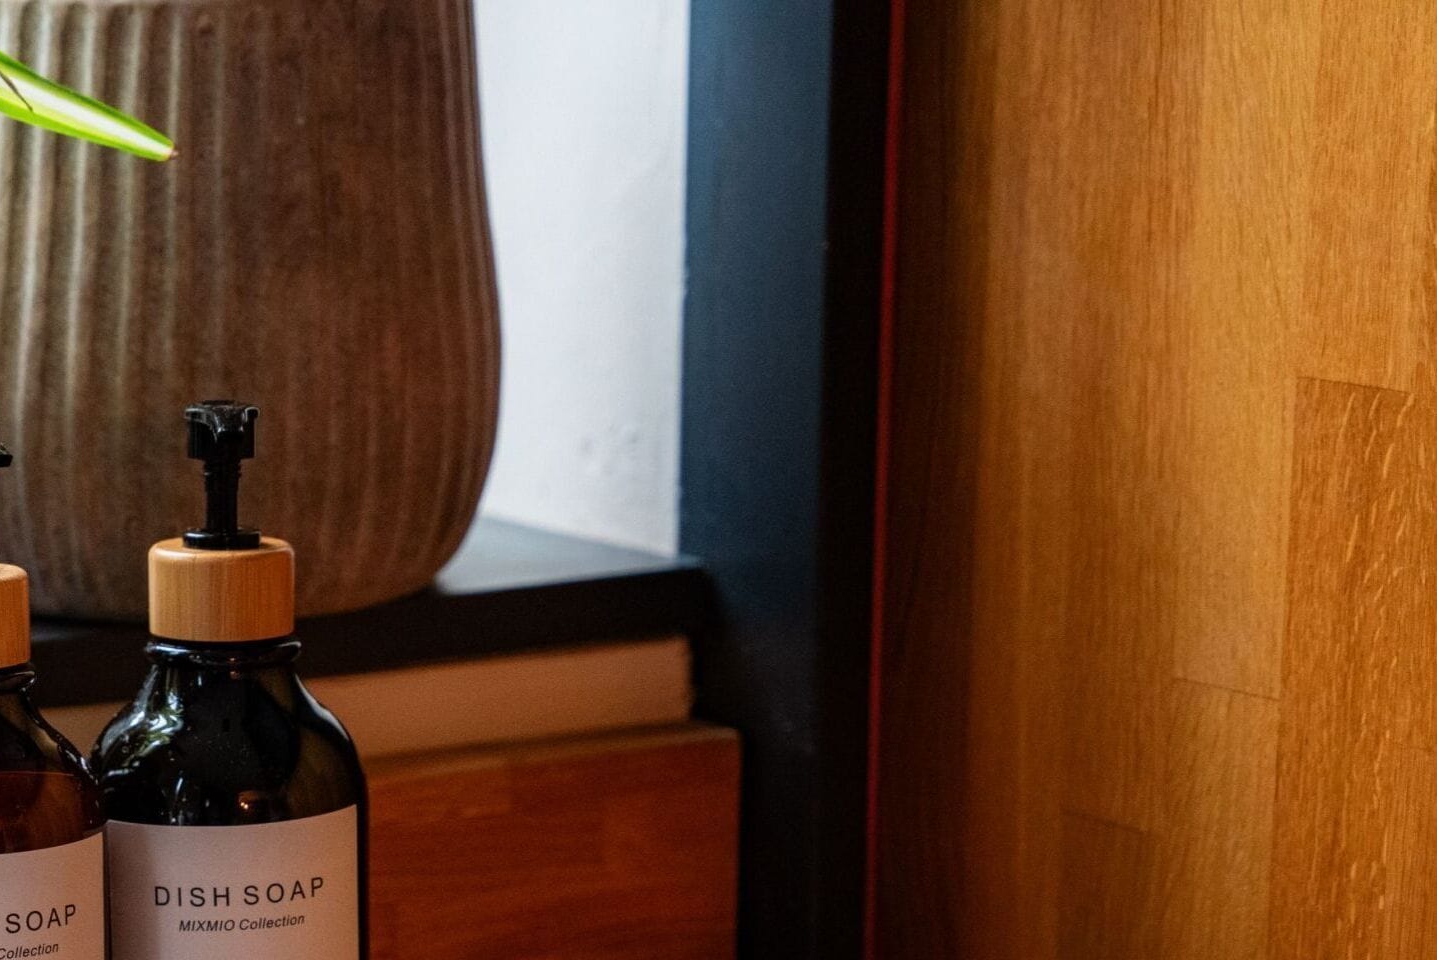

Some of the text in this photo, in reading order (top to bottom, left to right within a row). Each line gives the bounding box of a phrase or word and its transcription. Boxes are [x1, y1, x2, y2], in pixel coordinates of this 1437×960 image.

[154, 876, 324, 907] DISH SOAP
[5, 904, 76, 934] SOAP
[179, 914, 305, 932] MIXMIO Collection
